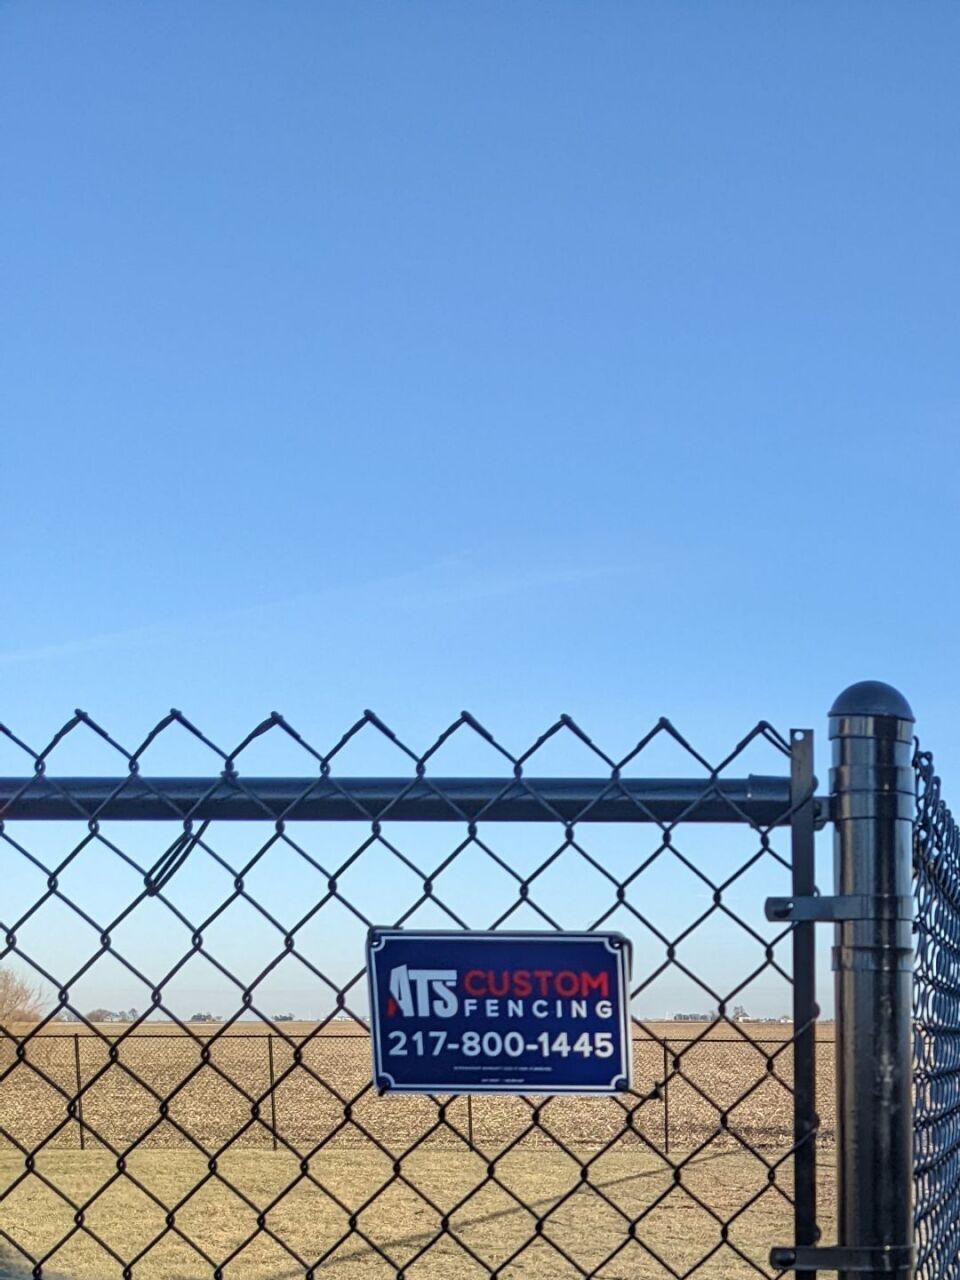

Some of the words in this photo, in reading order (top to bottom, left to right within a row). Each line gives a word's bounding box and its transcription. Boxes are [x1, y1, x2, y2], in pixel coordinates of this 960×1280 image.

[387, 964, 458, 1017] ATS
[463, 970, 609, 996] CUSTOM
[464, 999, 613, 1018] FENCING
[388, 1031, 614, 1058] 217-800-1445
